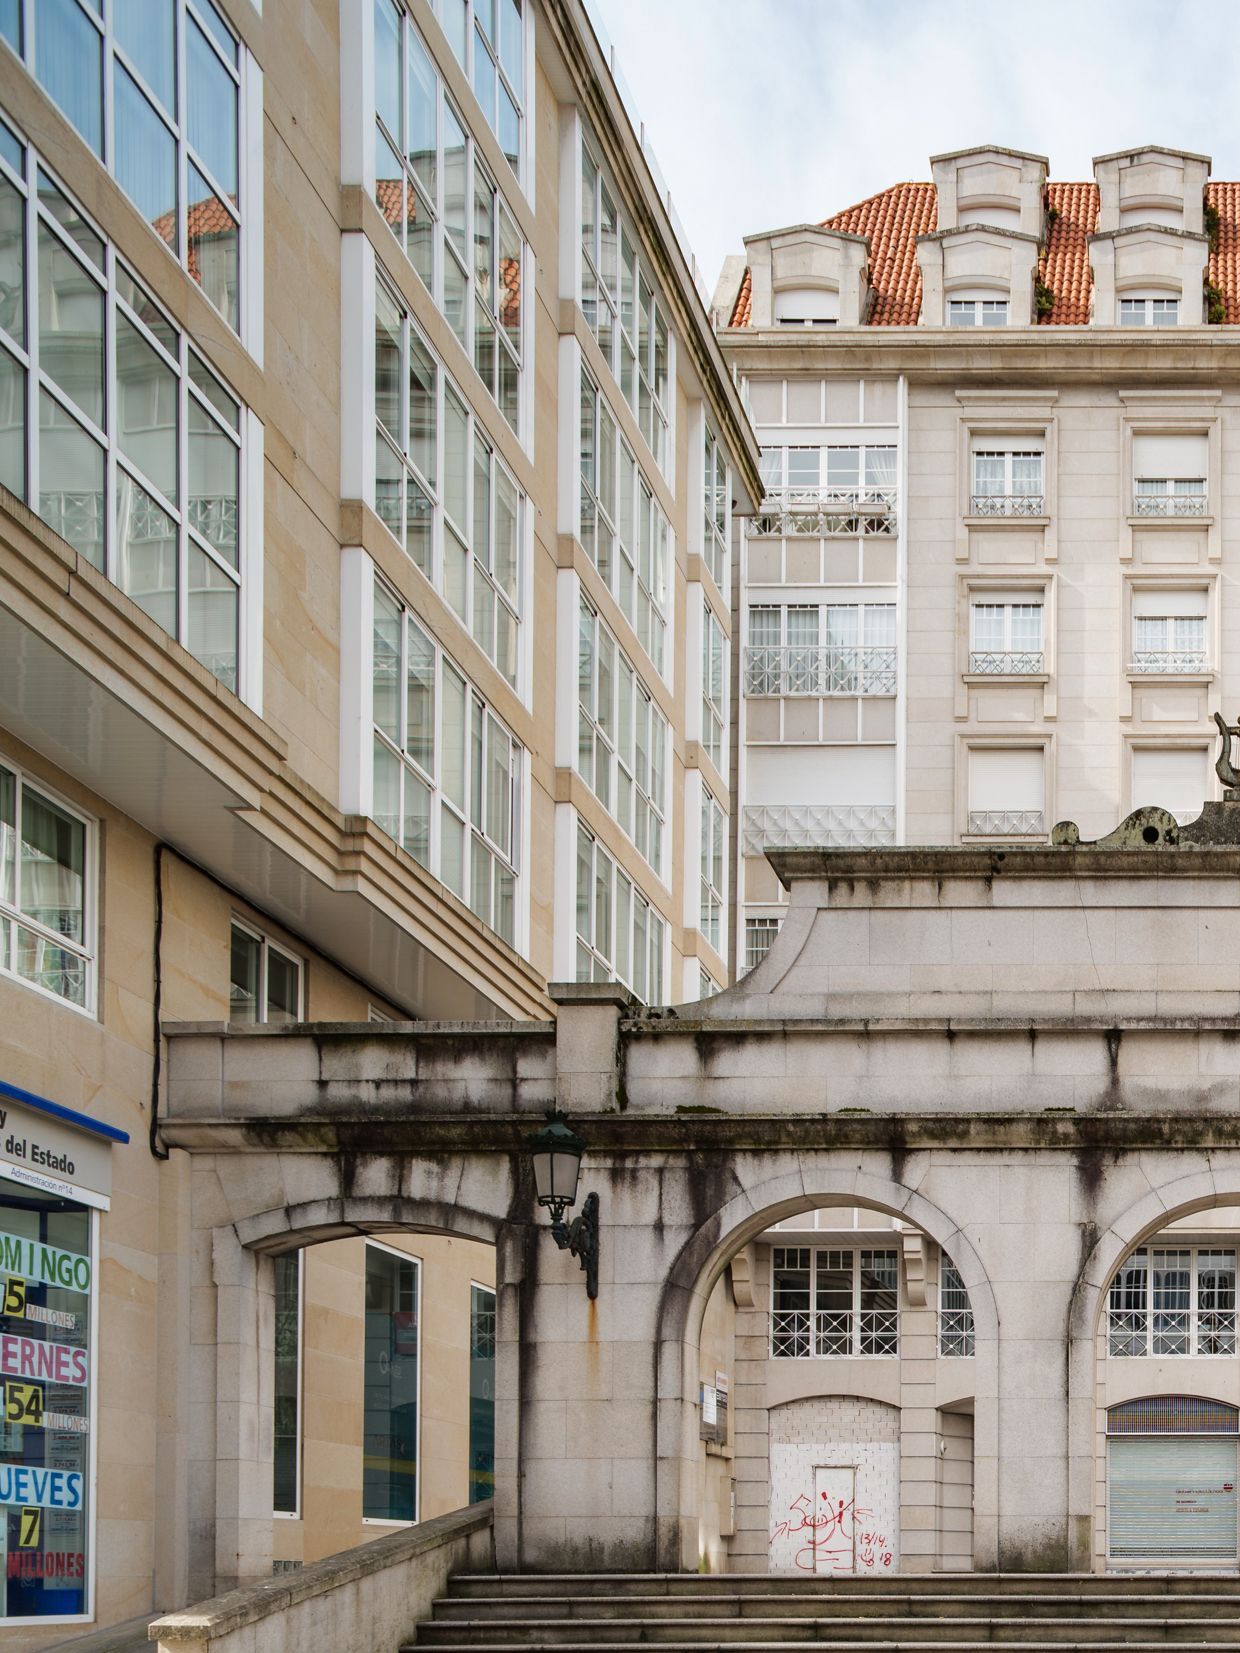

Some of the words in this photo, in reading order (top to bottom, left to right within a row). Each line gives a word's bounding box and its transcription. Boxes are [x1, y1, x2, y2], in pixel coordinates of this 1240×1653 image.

[6, 1135, 26, 1159] del
[31, 1144, 75, 1175] Estado
[11, 1168, 57, 1192] Administración
[27, 1305, 75, 1329] MILLONES
[2, 1336, 87, 1384] ERNES
[8, 1385, 42, 1424] 54
[47, 1412, 89, 1433] MILLONES
[23, 1509, 39, 1545] 7
[7, 1551, 84, 1579] MILLONES
